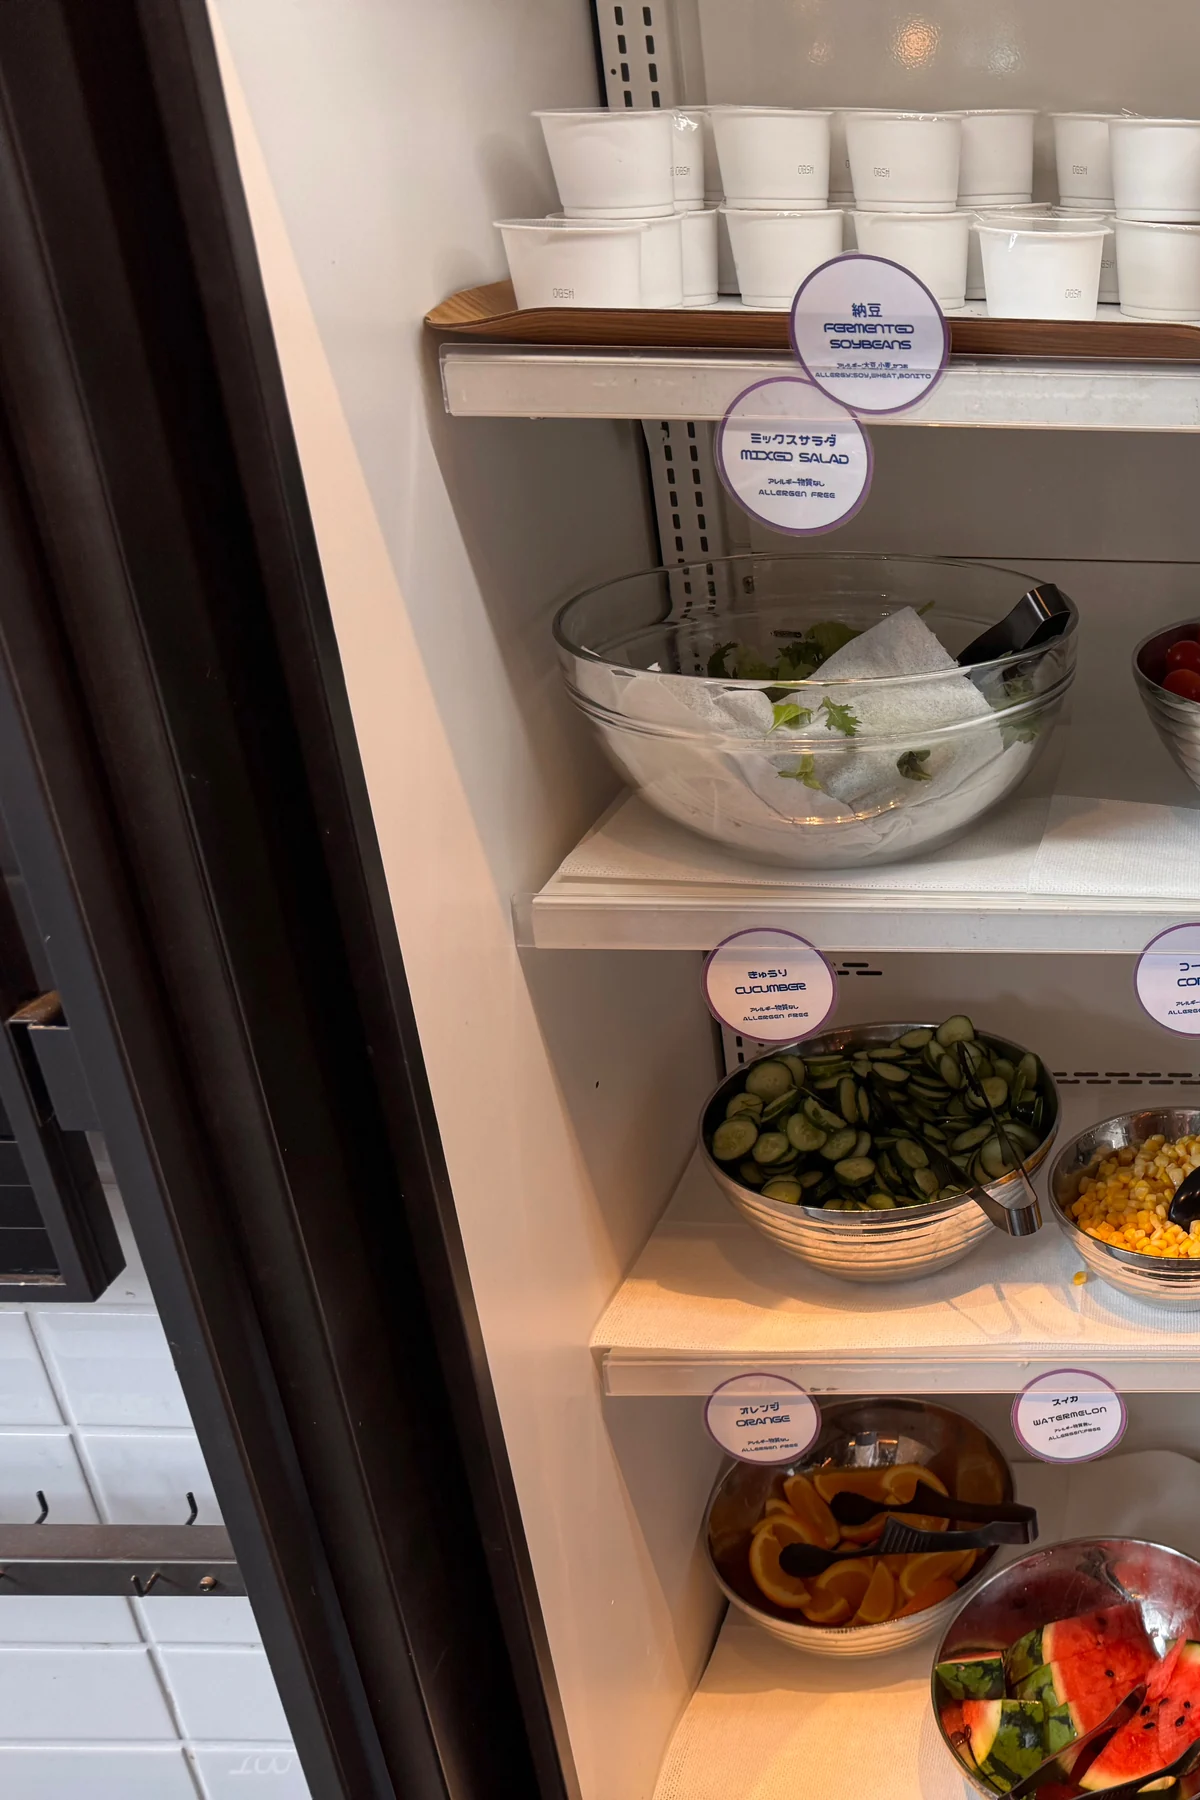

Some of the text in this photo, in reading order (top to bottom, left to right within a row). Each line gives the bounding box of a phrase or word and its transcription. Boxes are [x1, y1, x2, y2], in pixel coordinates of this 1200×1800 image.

[852, 303, 883, 318] 納豆
[823, 322, 915, 334] FERMENTED
[829, 339, 912, 350] SOYBEANS
[750, 433, 837, 447] ミックスサラダ
[740, 449, 850, 465] MIXED SALAD
[758, 489, 836, 499] ALLERGEN FREE
[747, 969, 788, 979] きゅうり
[734, 982, 807, 995] CUCUMBER
[742, 1013, 785, 1021] ALLERGEN
[1051, 1395, 1079, 1407] スイカ
[740, 1401, 780, 1415] オレンジ
[735, 1414, 791, 1427] ORANGE
[1032, 1406, 1107, 1427] WATERMELON
